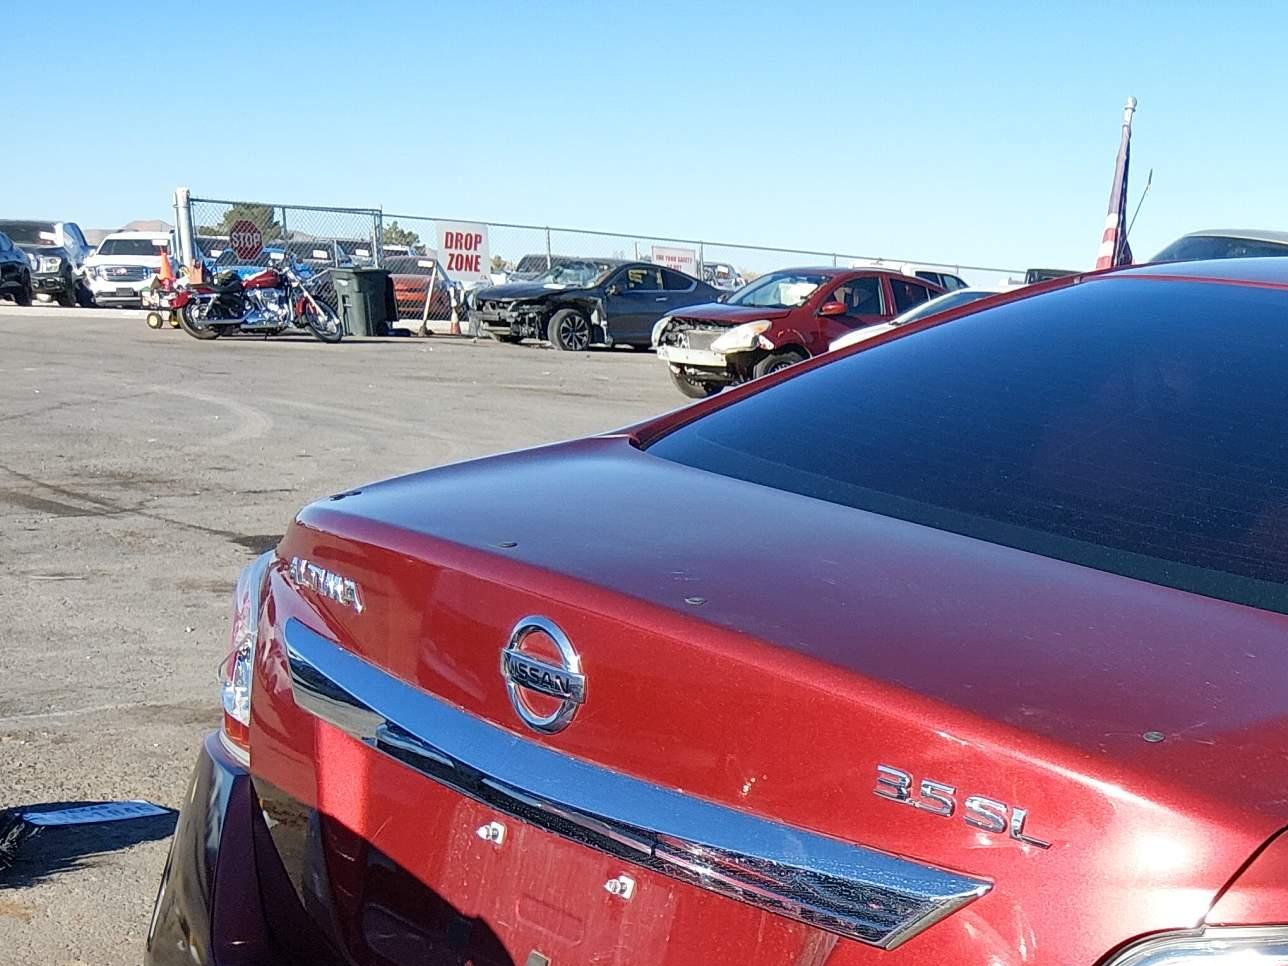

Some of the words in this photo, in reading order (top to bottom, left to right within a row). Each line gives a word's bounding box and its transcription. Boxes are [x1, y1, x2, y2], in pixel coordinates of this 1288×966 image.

[231, 232, 261, 248] STOP
[444, 231, 482, 251] DROP
[447, 252, 481, 272] ZONE
[290, 556, 366, 615] ALTIMA
[503, 652, 571, 696] NISSAN
[963, 794, 1053, 850] SL
